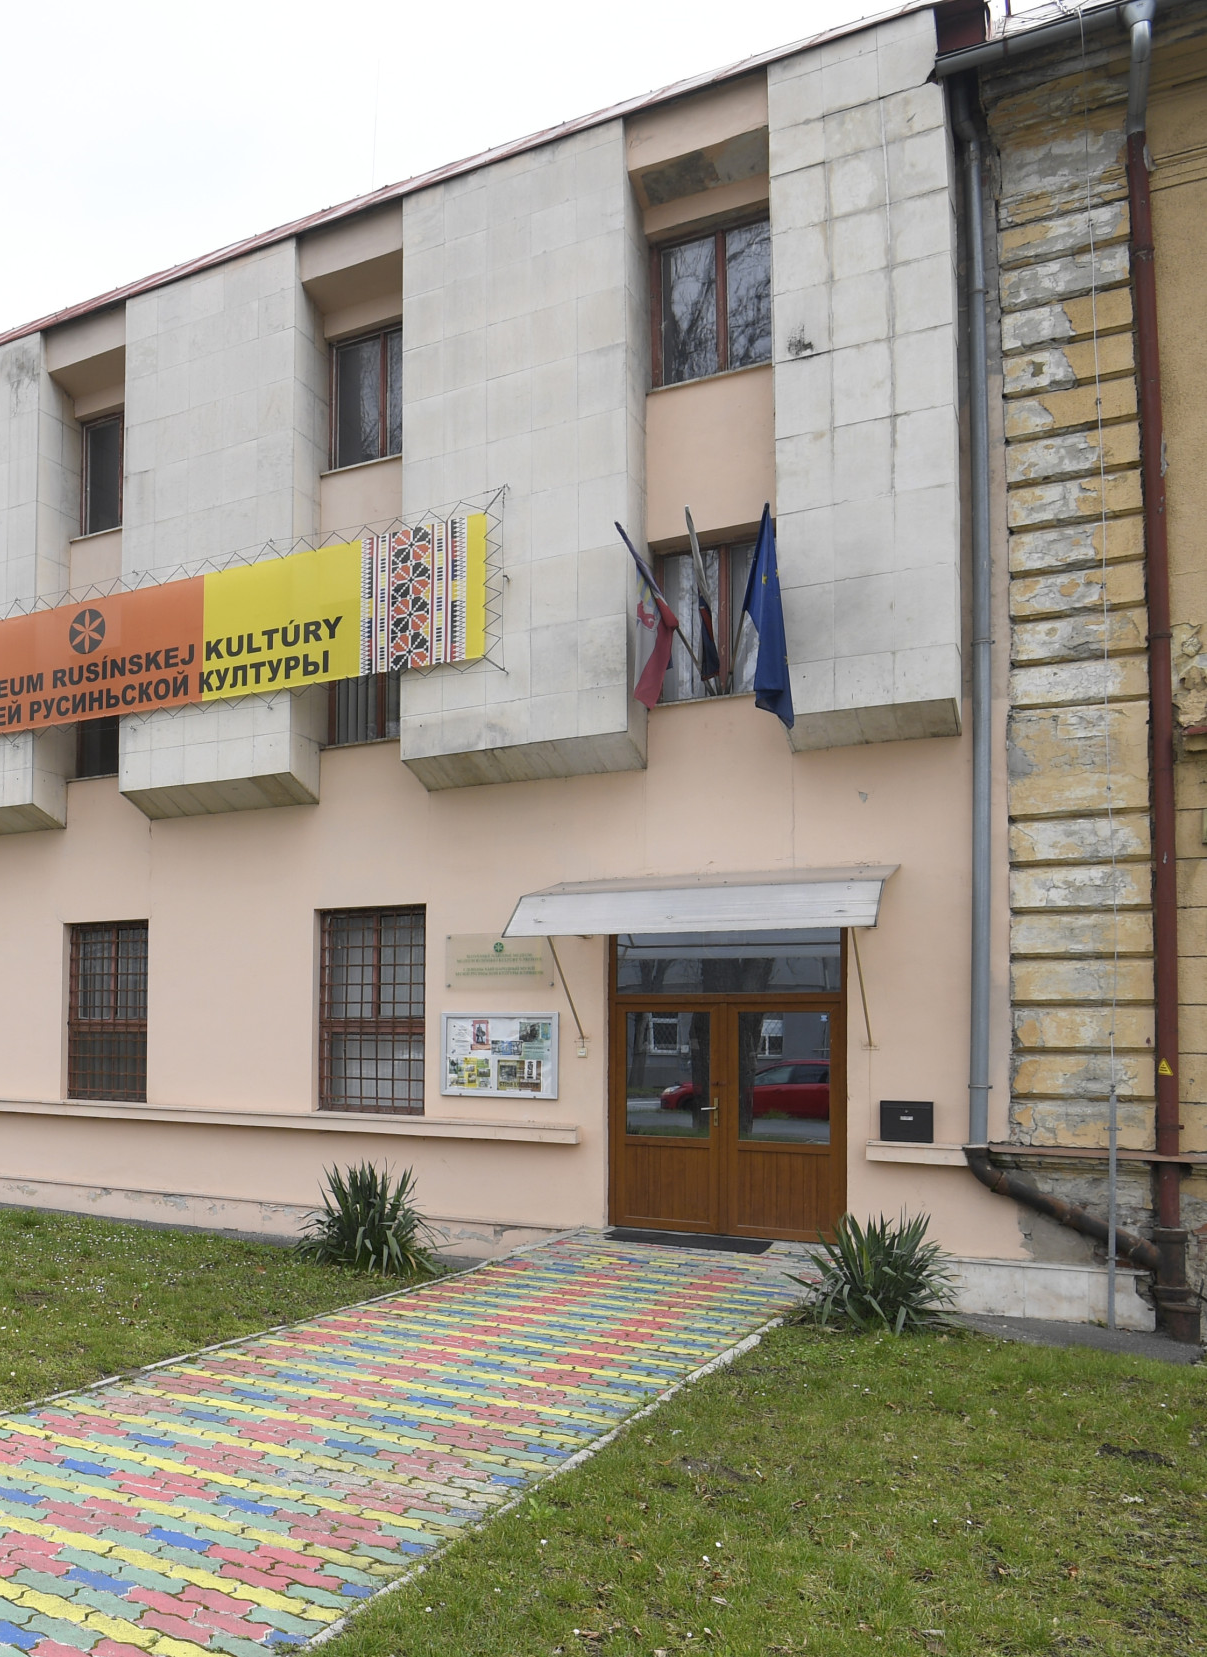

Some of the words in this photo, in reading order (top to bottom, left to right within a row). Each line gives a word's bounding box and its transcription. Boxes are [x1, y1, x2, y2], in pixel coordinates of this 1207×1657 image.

[29, 669, 189, 721] РУСИНЬСКОЙ
[198, 650, 330, 693] КУЛТУРЫ
[52, 644, 195, 689] RUSÍNSKEJ
[205, 615, 344, 662] KULTÚRY
